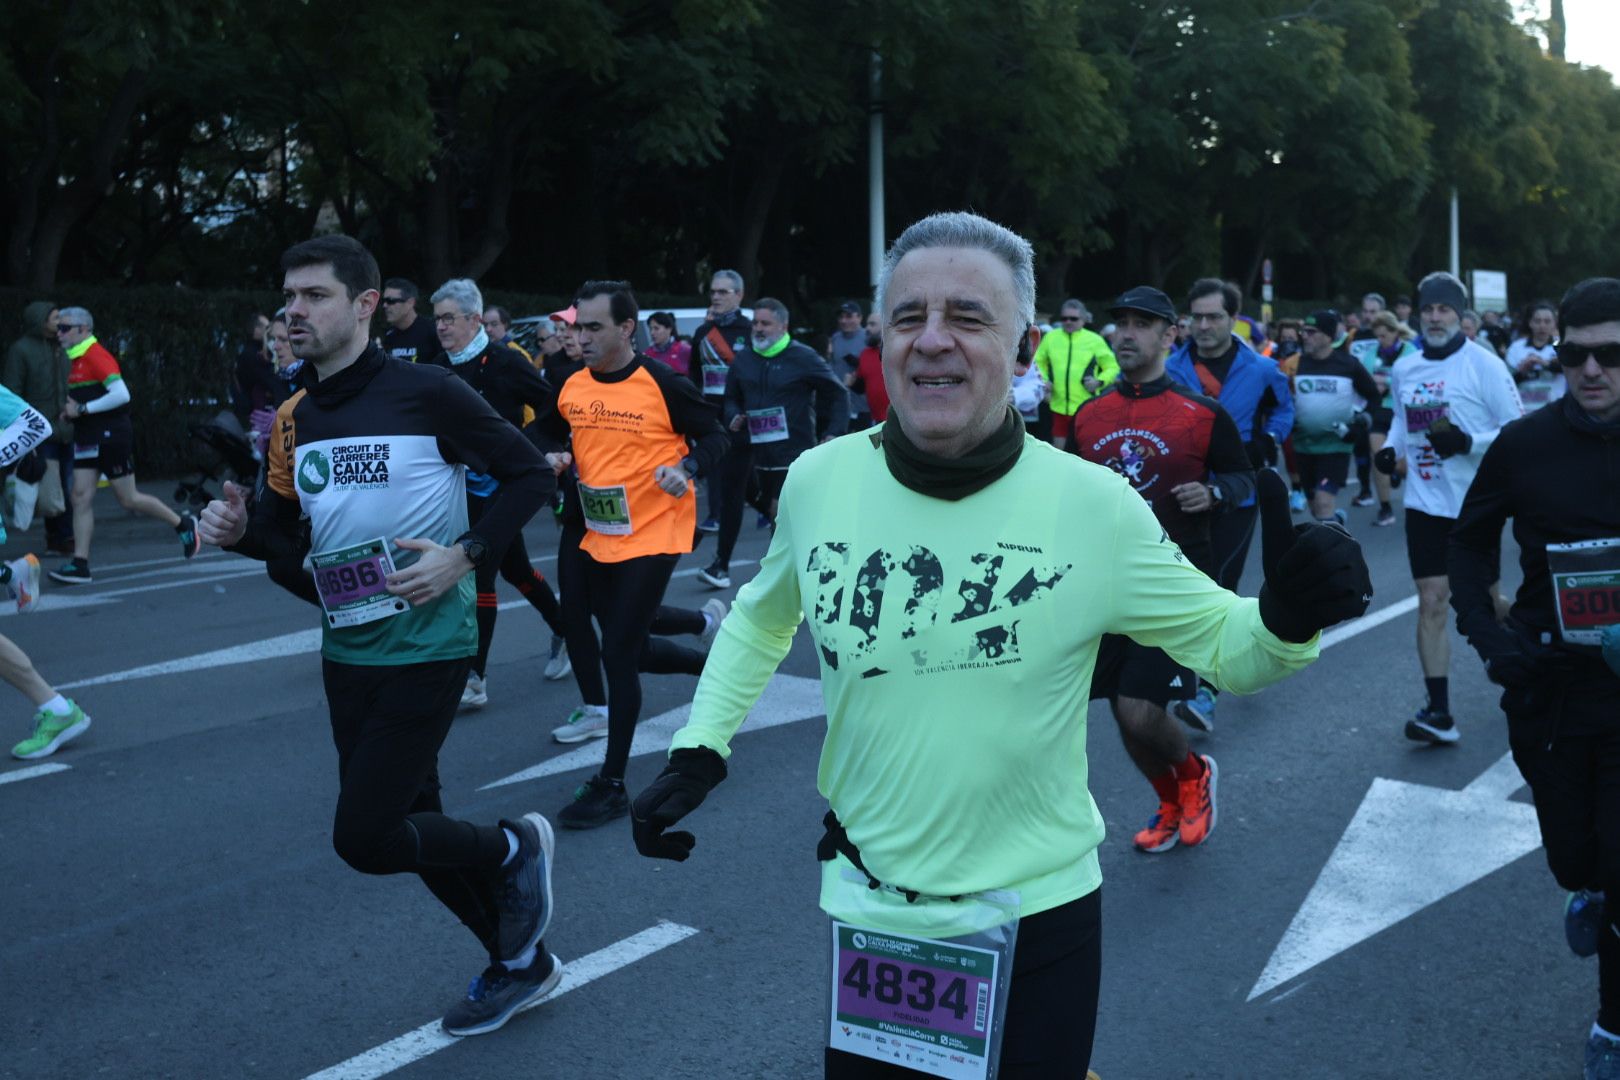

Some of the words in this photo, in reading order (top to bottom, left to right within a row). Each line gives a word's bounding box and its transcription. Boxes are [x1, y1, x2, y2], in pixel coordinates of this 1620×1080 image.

[1092, 428, 1169, 455] CORRECANSINOS
[332, 444, 371, 455] CIRCUIT
[374, 443, 390, 452] DE
[332, 452, 390, 464] CARRERES
[333, 461, 389, 476] CAIXA
[334, 474, 389, 486] POPULAR
[997, 542, 1043, 554] KIPRUN
[957, 662, 989, 670] IBERCAJA
[842, 957, 968, 1021] 4834
